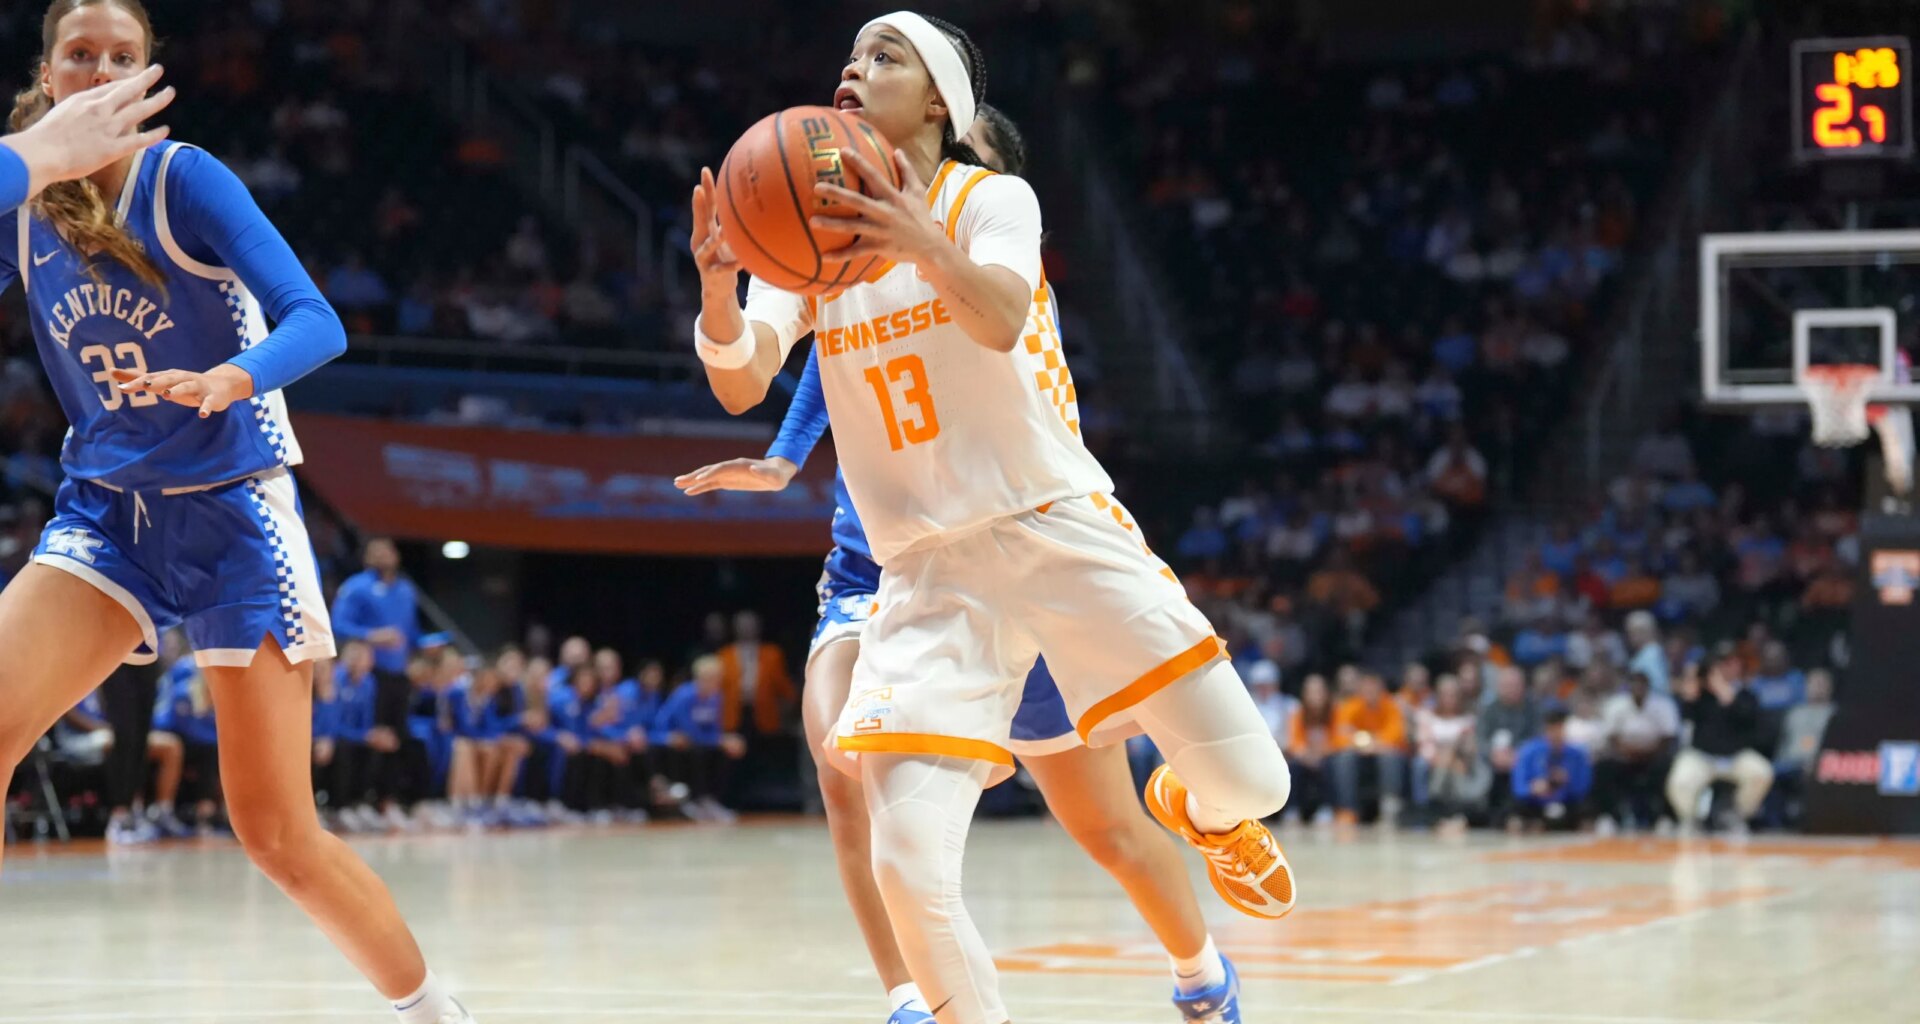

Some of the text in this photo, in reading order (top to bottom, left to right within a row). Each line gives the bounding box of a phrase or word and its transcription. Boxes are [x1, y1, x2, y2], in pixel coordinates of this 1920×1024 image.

[49, 283, 174, 350] KENTUCKY
[815, 298, 952, 358] TENNESSE
[79, 341, 159, 412] 32
[863, 353, 941, 452] 13
